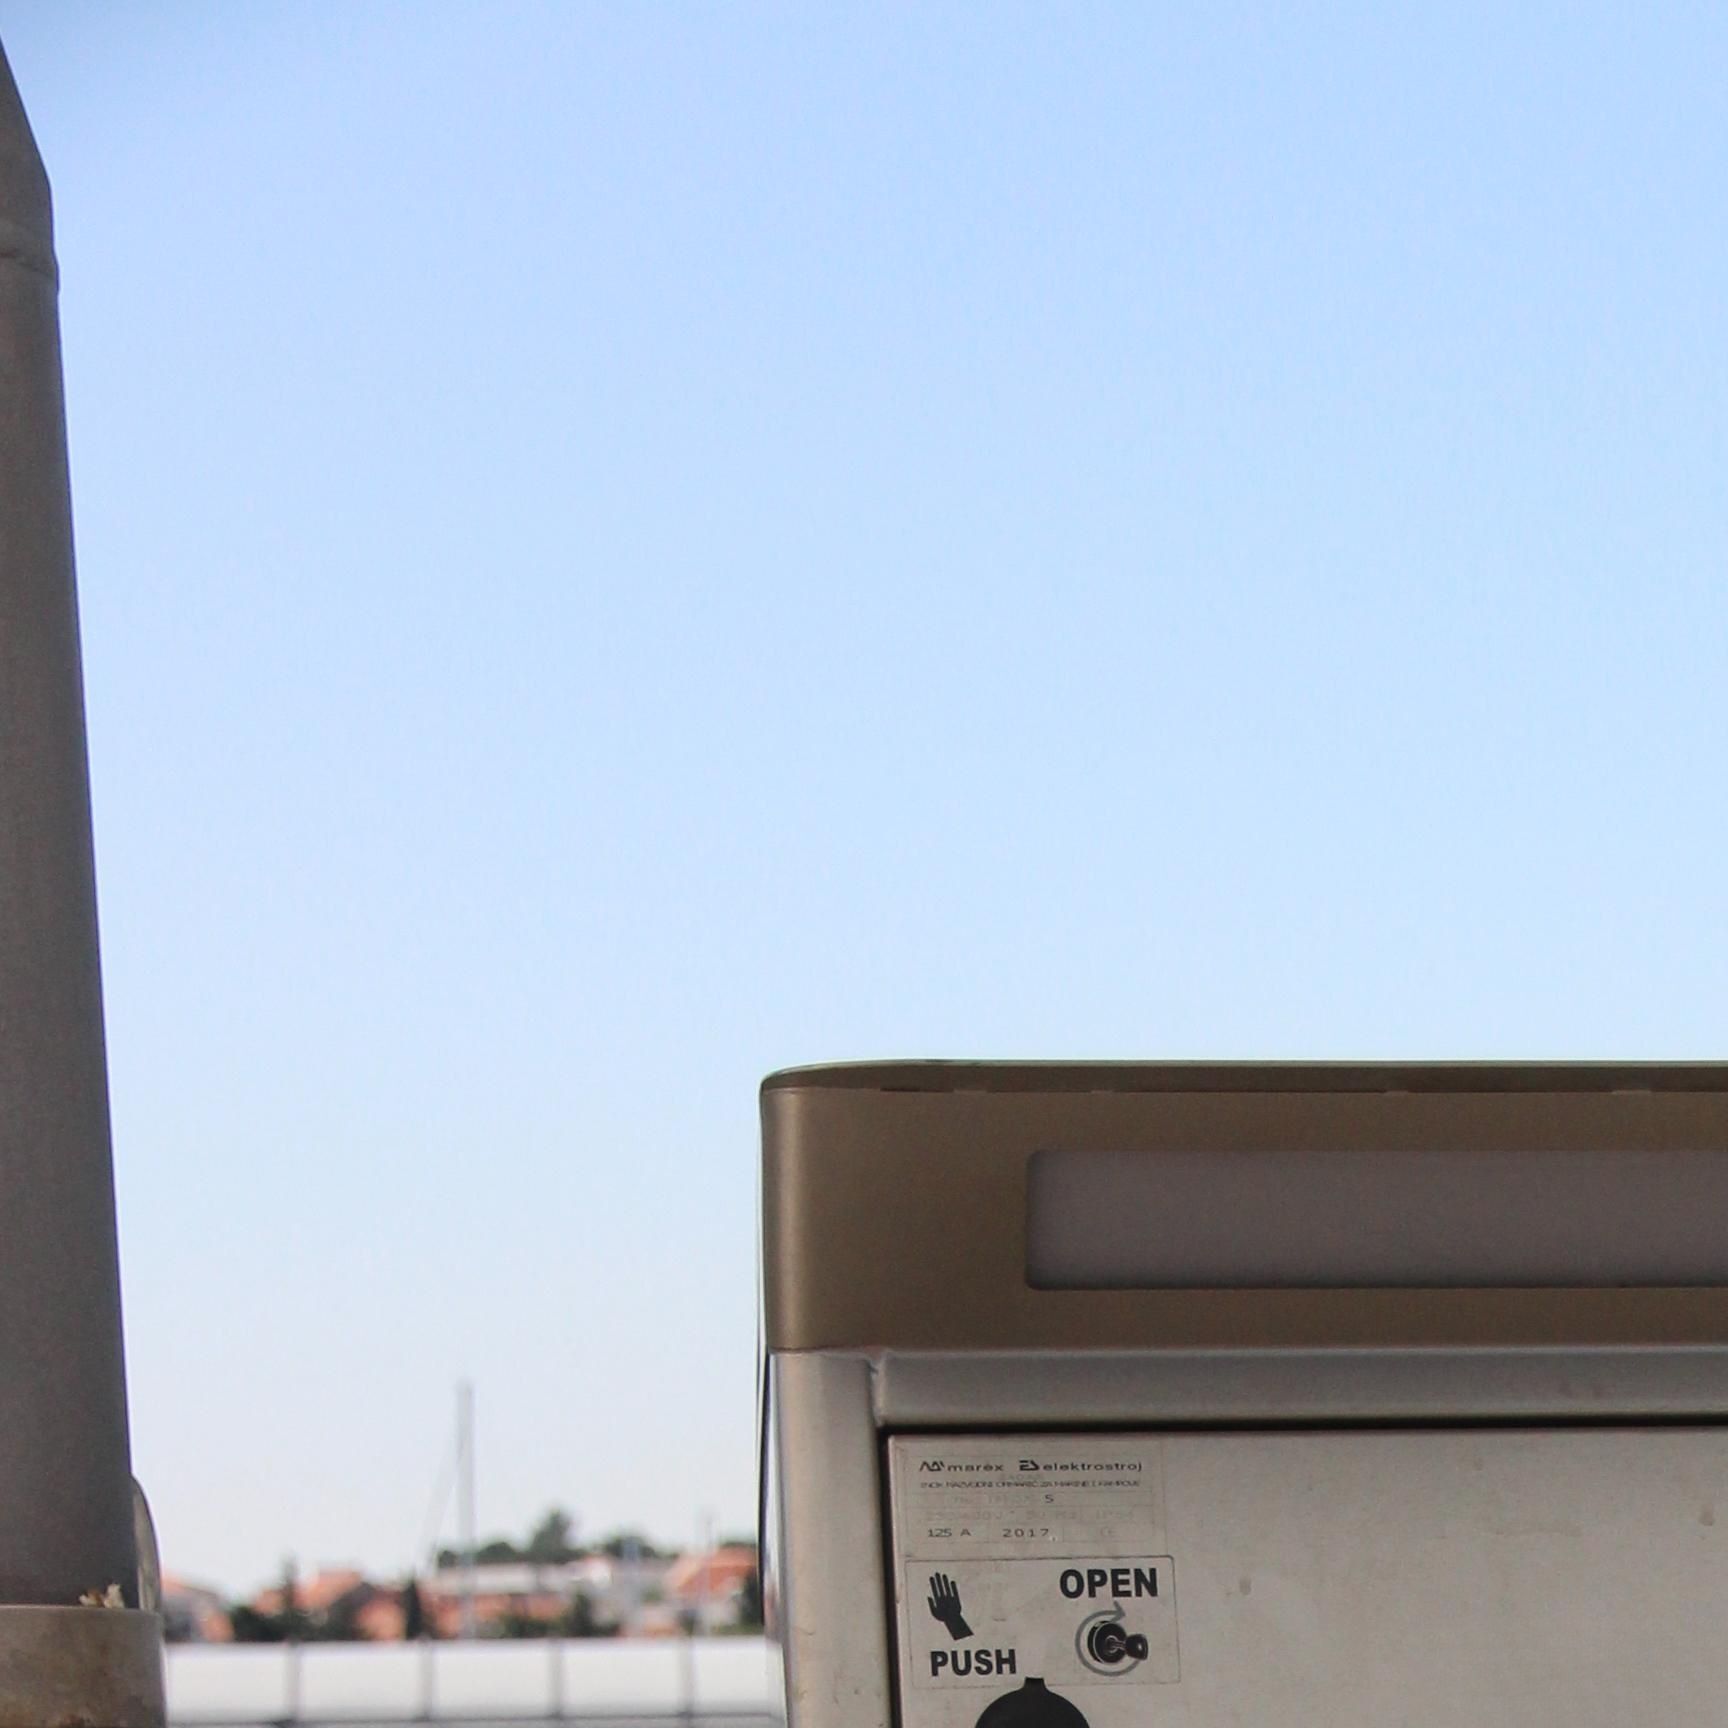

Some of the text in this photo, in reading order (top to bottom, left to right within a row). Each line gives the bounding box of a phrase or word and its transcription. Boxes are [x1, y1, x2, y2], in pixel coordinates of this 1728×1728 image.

[927, 1528, 953, 1538] 125
[960, 1528, 972, 1537] A
[1059, 1568, 1158, 1599] OPEN
[930, 1649, 1016, 1677] PUSH
